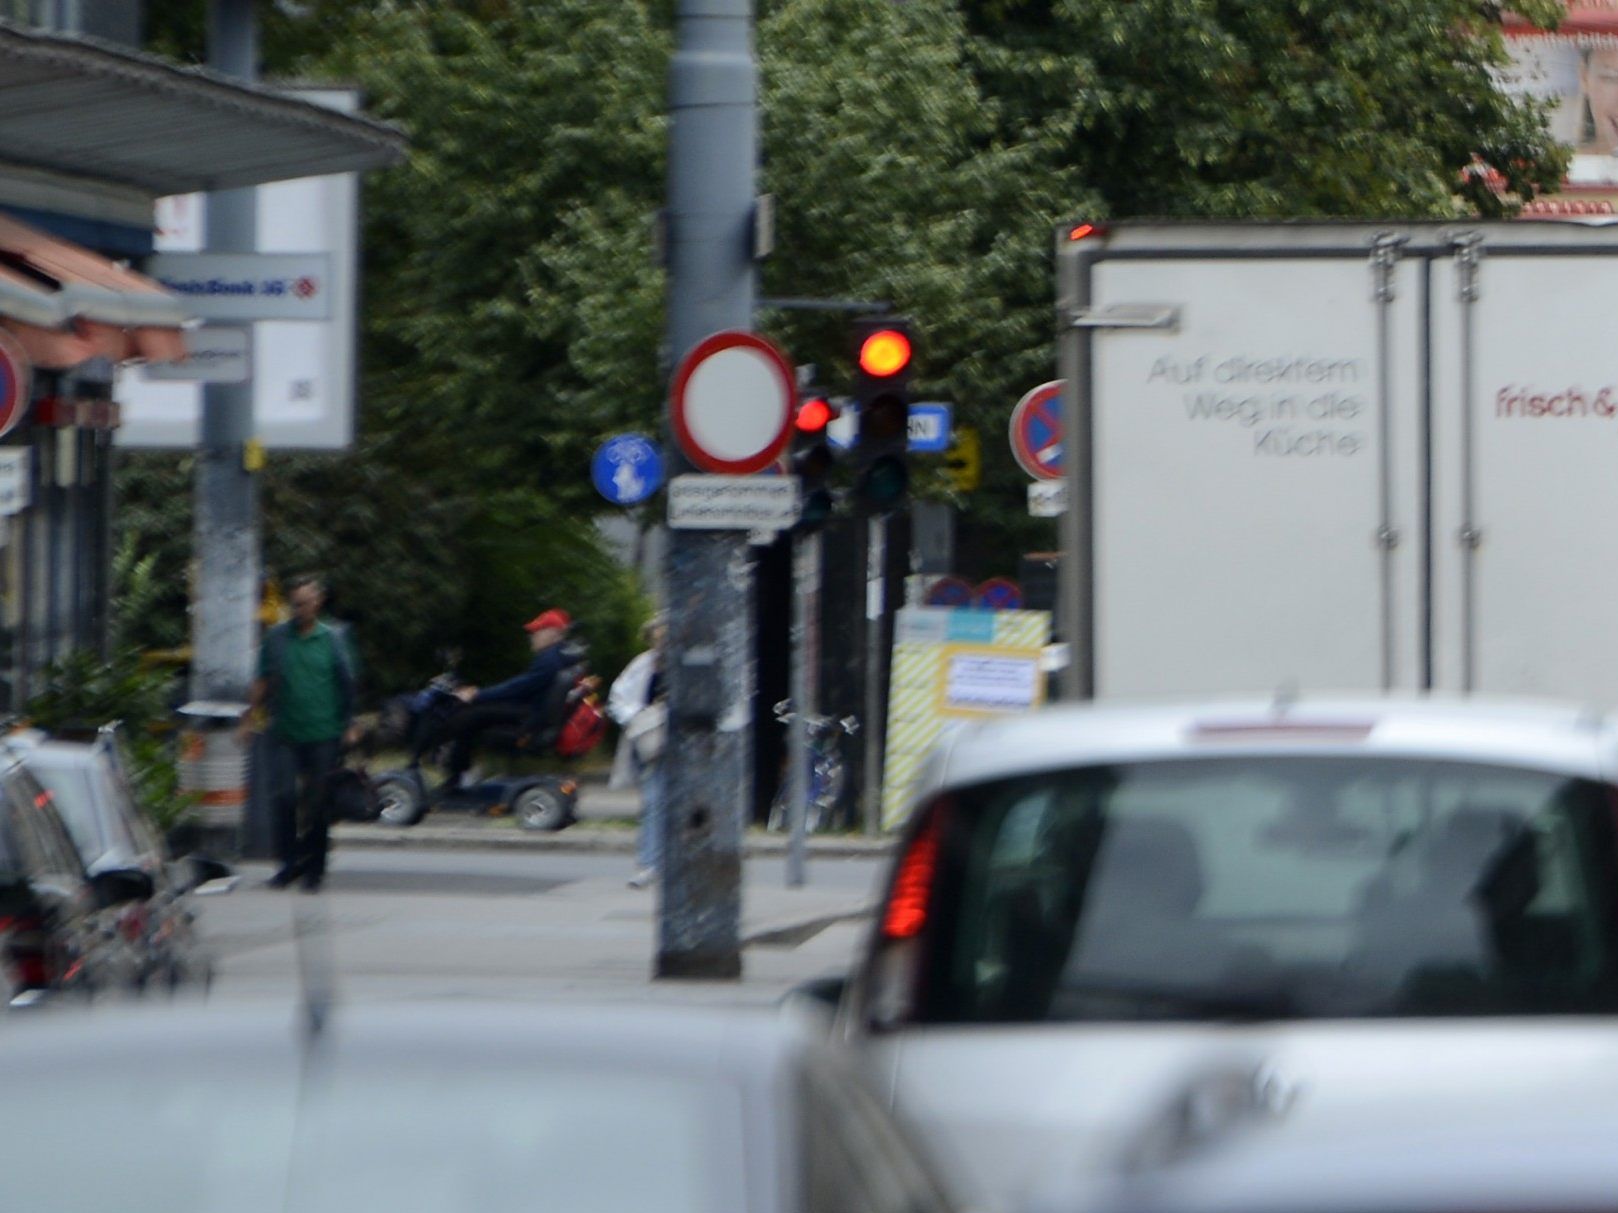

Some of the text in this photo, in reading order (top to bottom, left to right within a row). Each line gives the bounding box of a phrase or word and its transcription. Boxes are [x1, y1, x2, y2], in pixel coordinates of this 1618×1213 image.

[1147, 354, 1359, 384] Auf direktem
[1184, 391, 1360, 428] Weg in die
[1254, 427, 1361, 458] Küche
